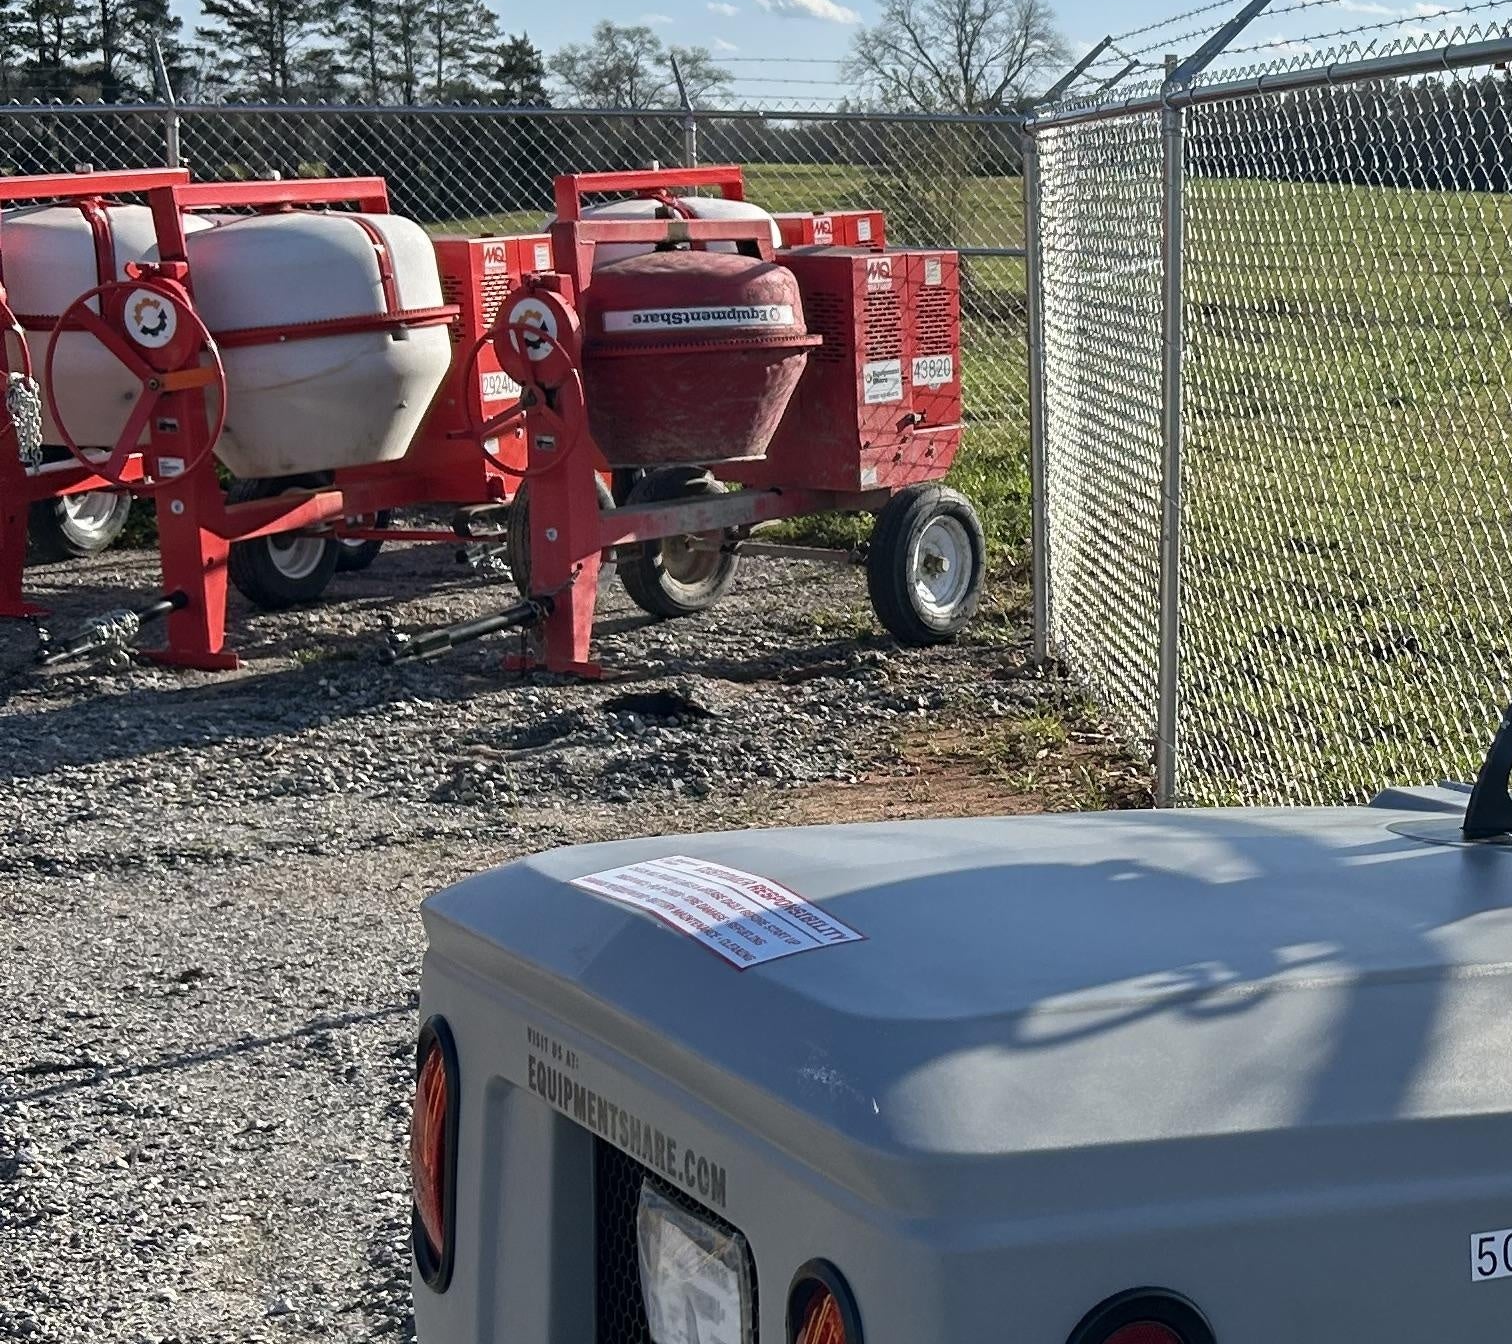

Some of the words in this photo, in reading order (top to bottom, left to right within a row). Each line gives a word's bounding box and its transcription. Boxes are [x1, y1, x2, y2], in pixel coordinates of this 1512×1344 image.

[485, 246, 506, 264] MQ
[632, 308, 768, 325] EquipmentShare
[914, 357, 951, 379] 43820
[747, 883, 849, 941] RESPONSIBILITY
[527, 1027, 548, 1053] VISIT
[552, 1041, 563, 1059] US
[566, 1052, 579, 1070] AT:
[527, 1054, 727, 1208] EQUIPMENTSHARE.COM
